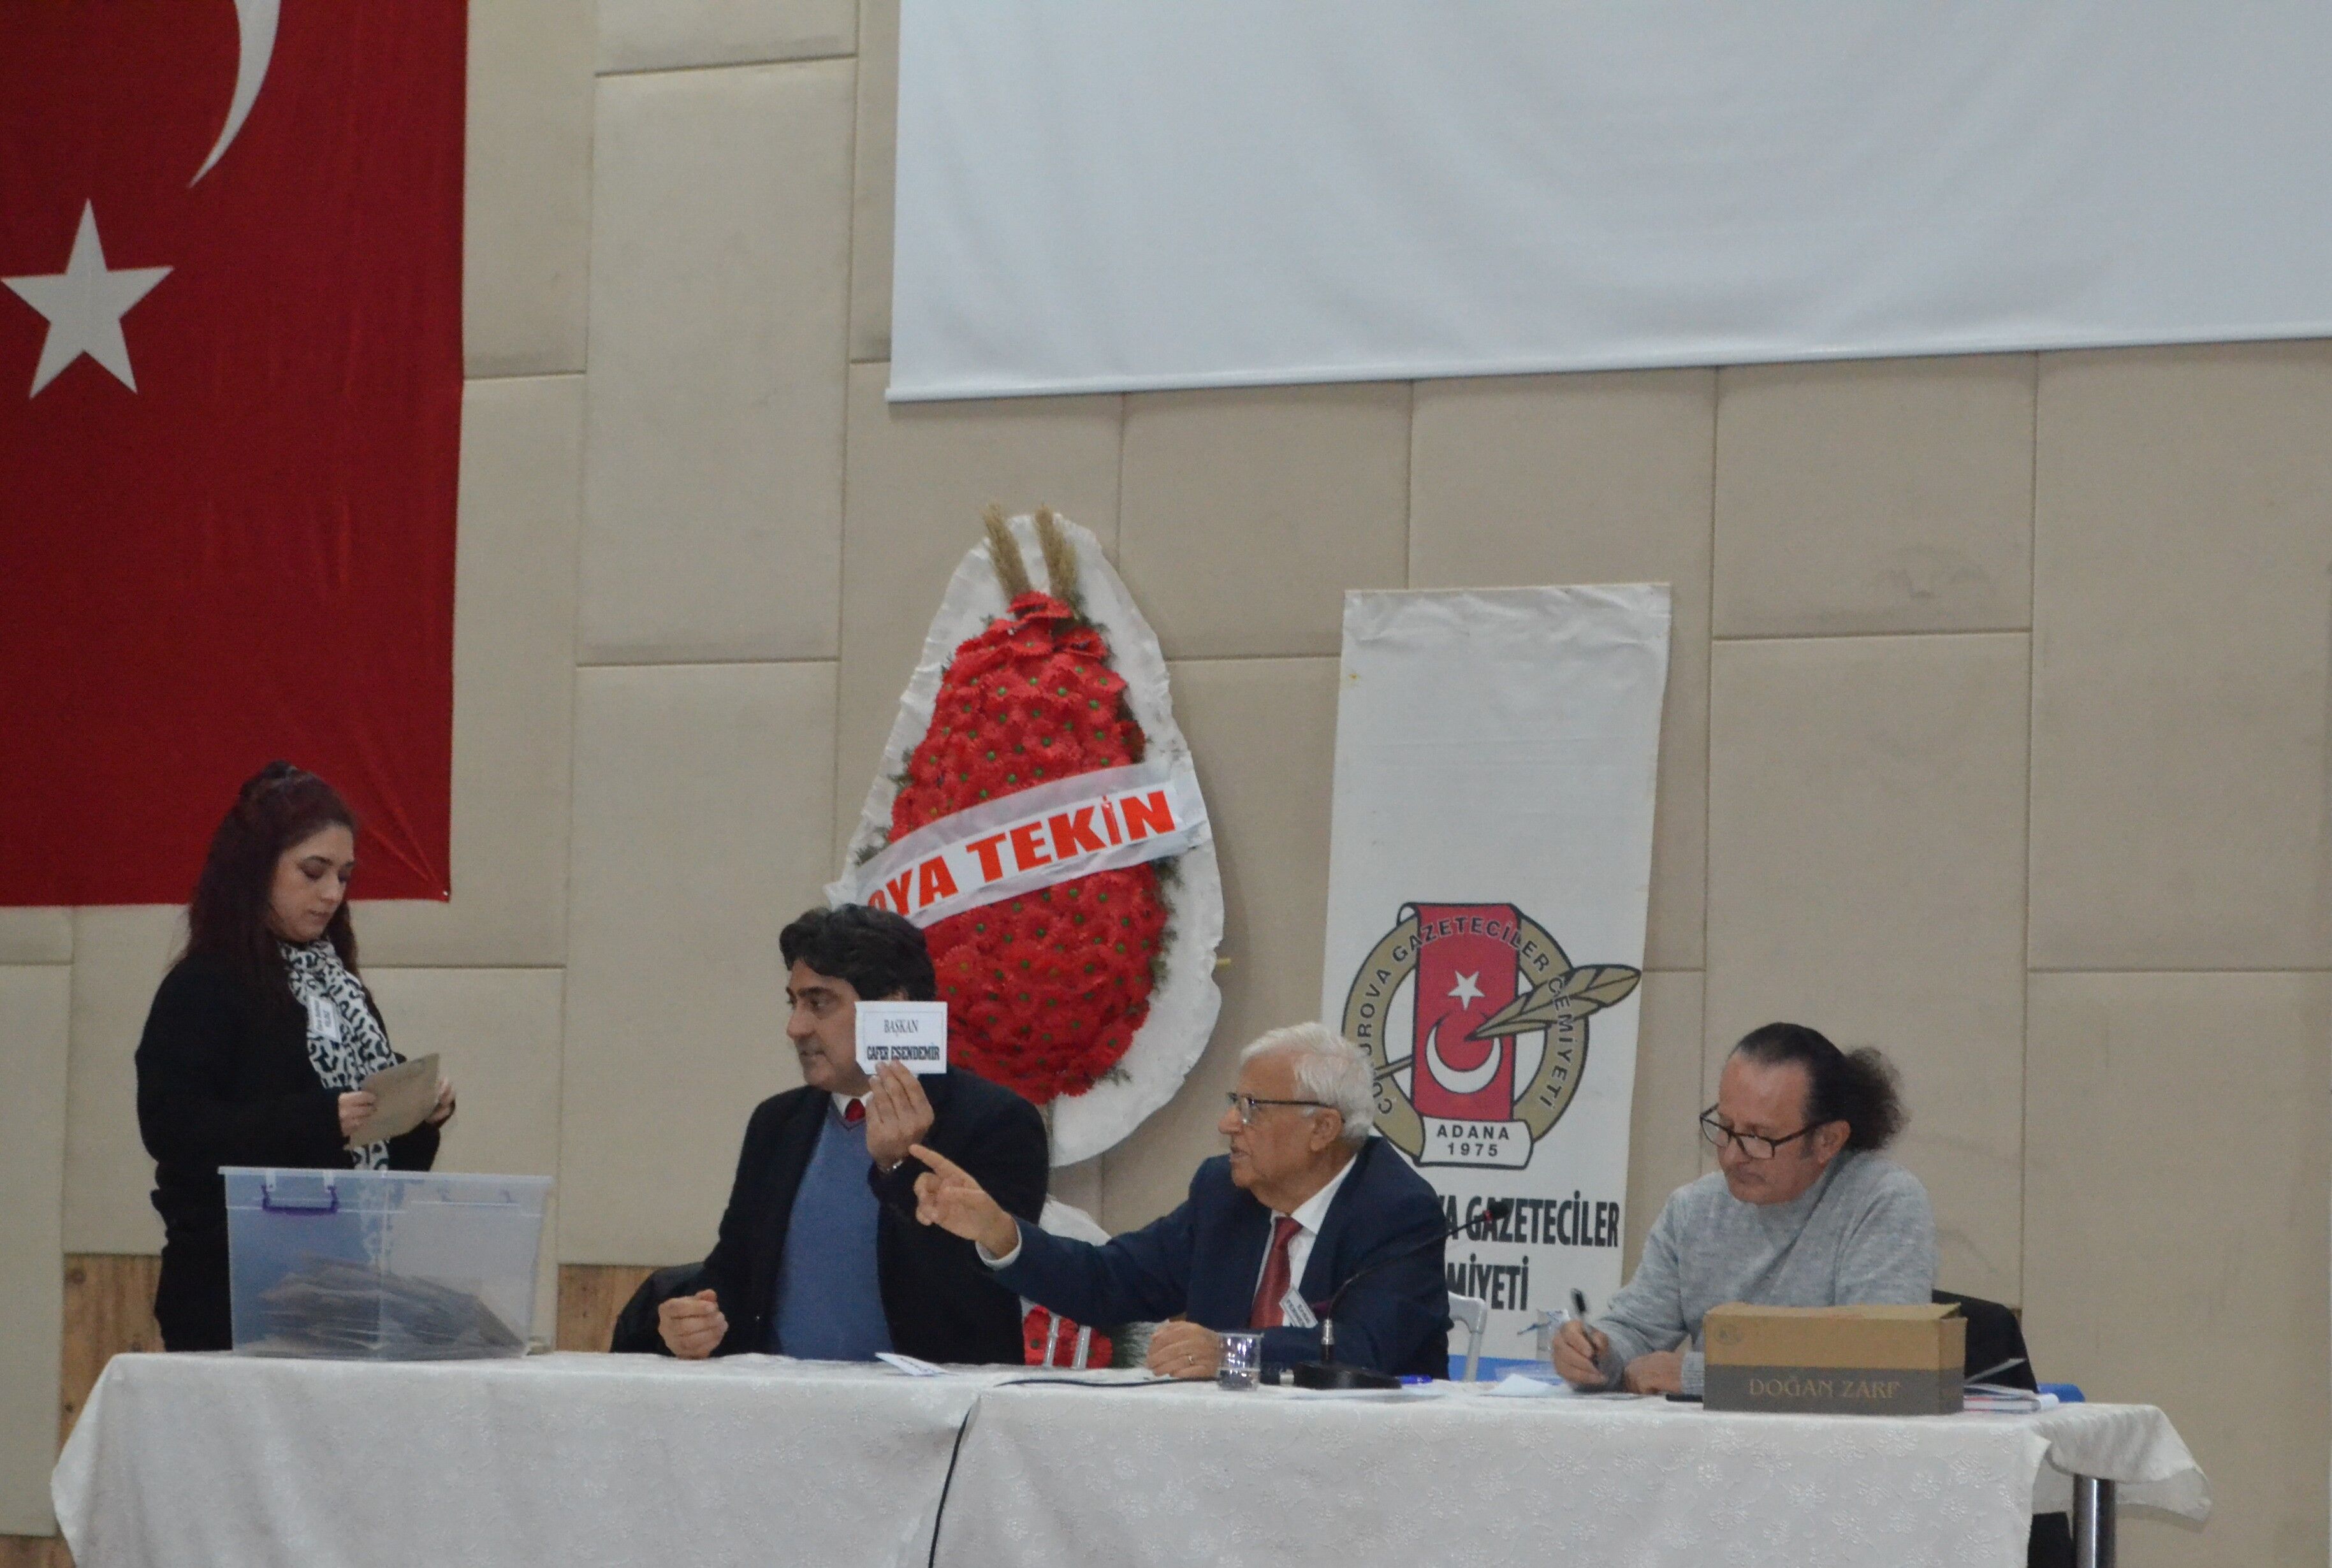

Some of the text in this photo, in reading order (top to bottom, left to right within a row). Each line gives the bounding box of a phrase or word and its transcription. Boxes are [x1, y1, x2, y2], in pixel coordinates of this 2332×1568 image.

[966, 790, 1176, 883] TEKİN
[884, 1019, 919, 1036] BAŞKAN
[1357, 916, 1577, 1115] ÇUUROVA GAZETECİLER CEMİYETİ
[866, 1046, 889, 1061] CAFER
[1436, 1124, 1510, 1140] ADANA
[1448, 1142, 1498, 1157] 1975
[1466, 1189, 1620, 1248] GAZETECİLER
[1445, 1252, 1529, 1311] MİYETİ
[1749, 1375, 1902, 1399] DOĞAN ZARF
